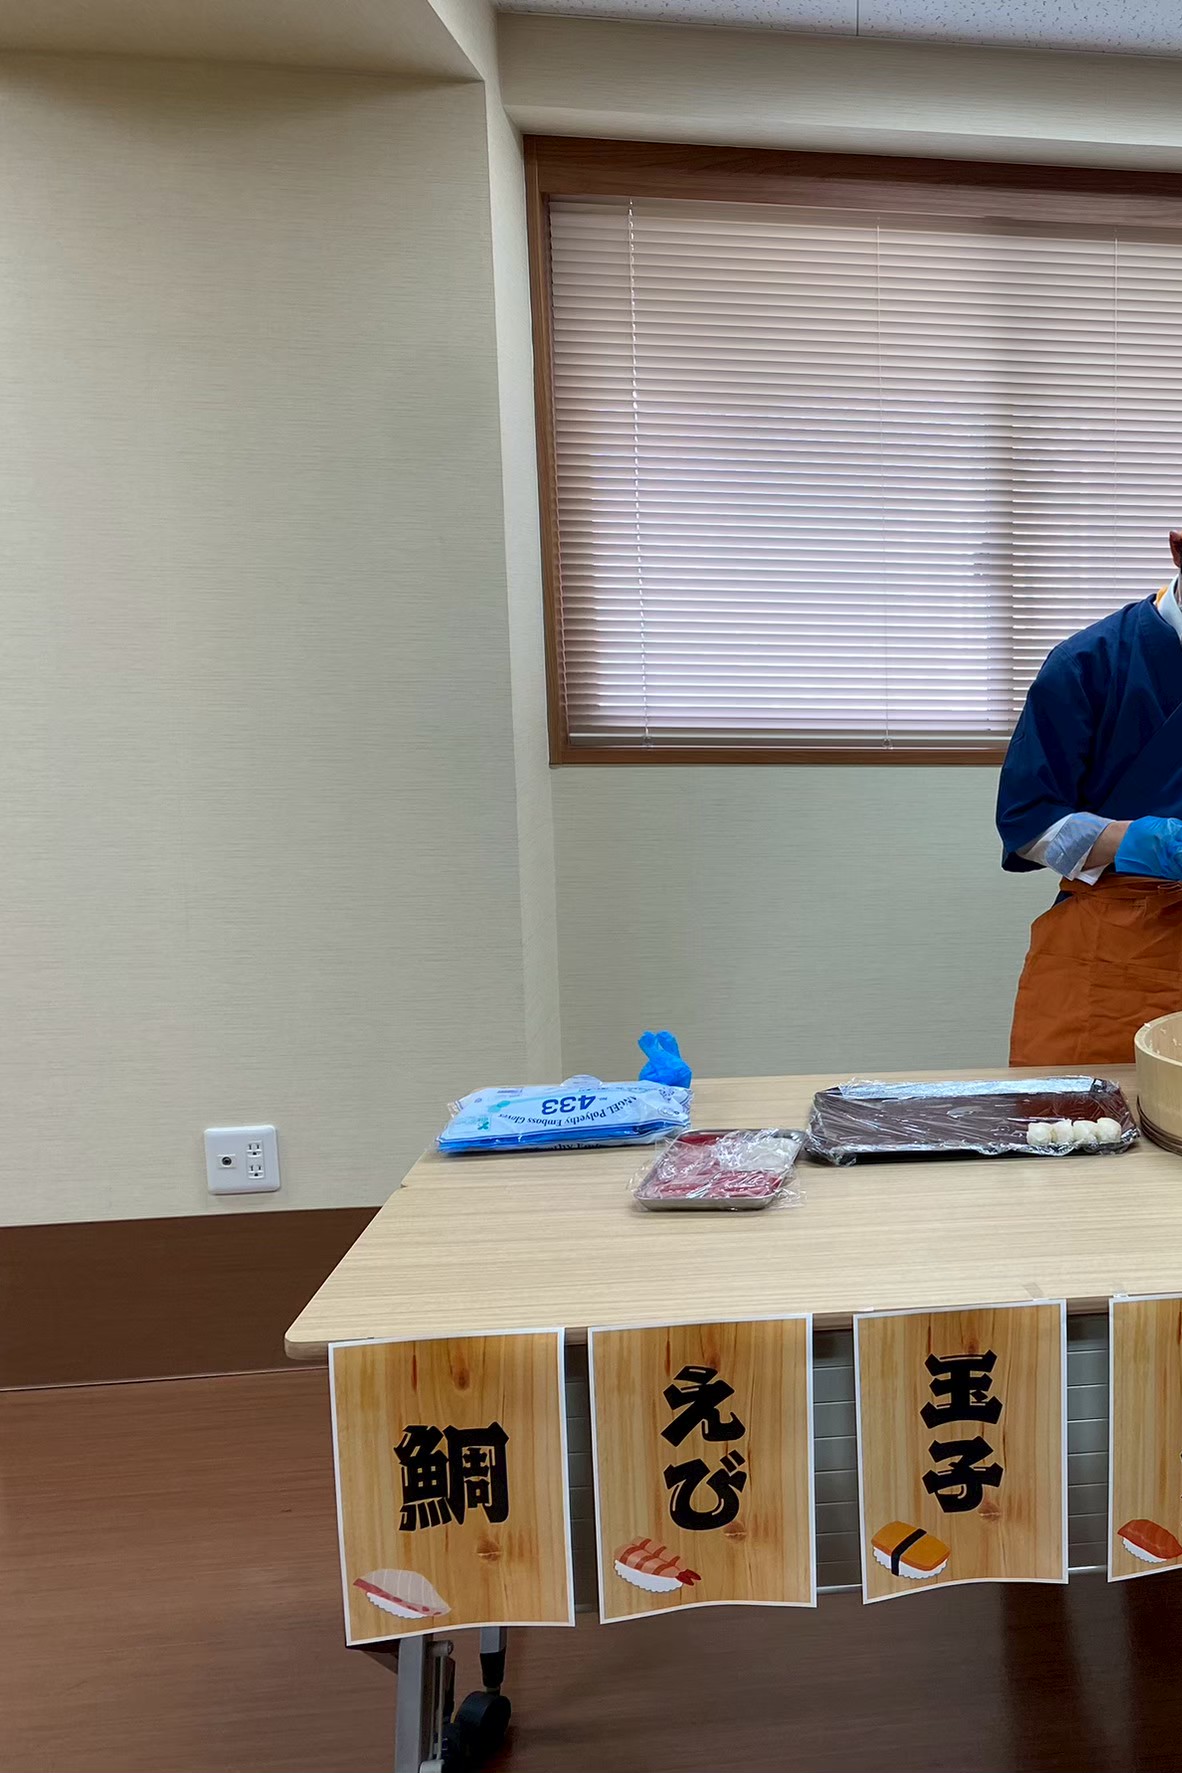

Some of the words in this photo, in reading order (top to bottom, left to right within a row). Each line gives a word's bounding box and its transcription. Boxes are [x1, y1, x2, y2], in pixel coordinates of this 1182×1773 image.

[527, 1117, 564, 1128] Emboss
[542, 1094, 597, 1116] 433
[393, 1421, 510, 1532] 鯛
[660, 1365, 748, 1531] えび
[919, 1349, 1004, 1515] 玉子
